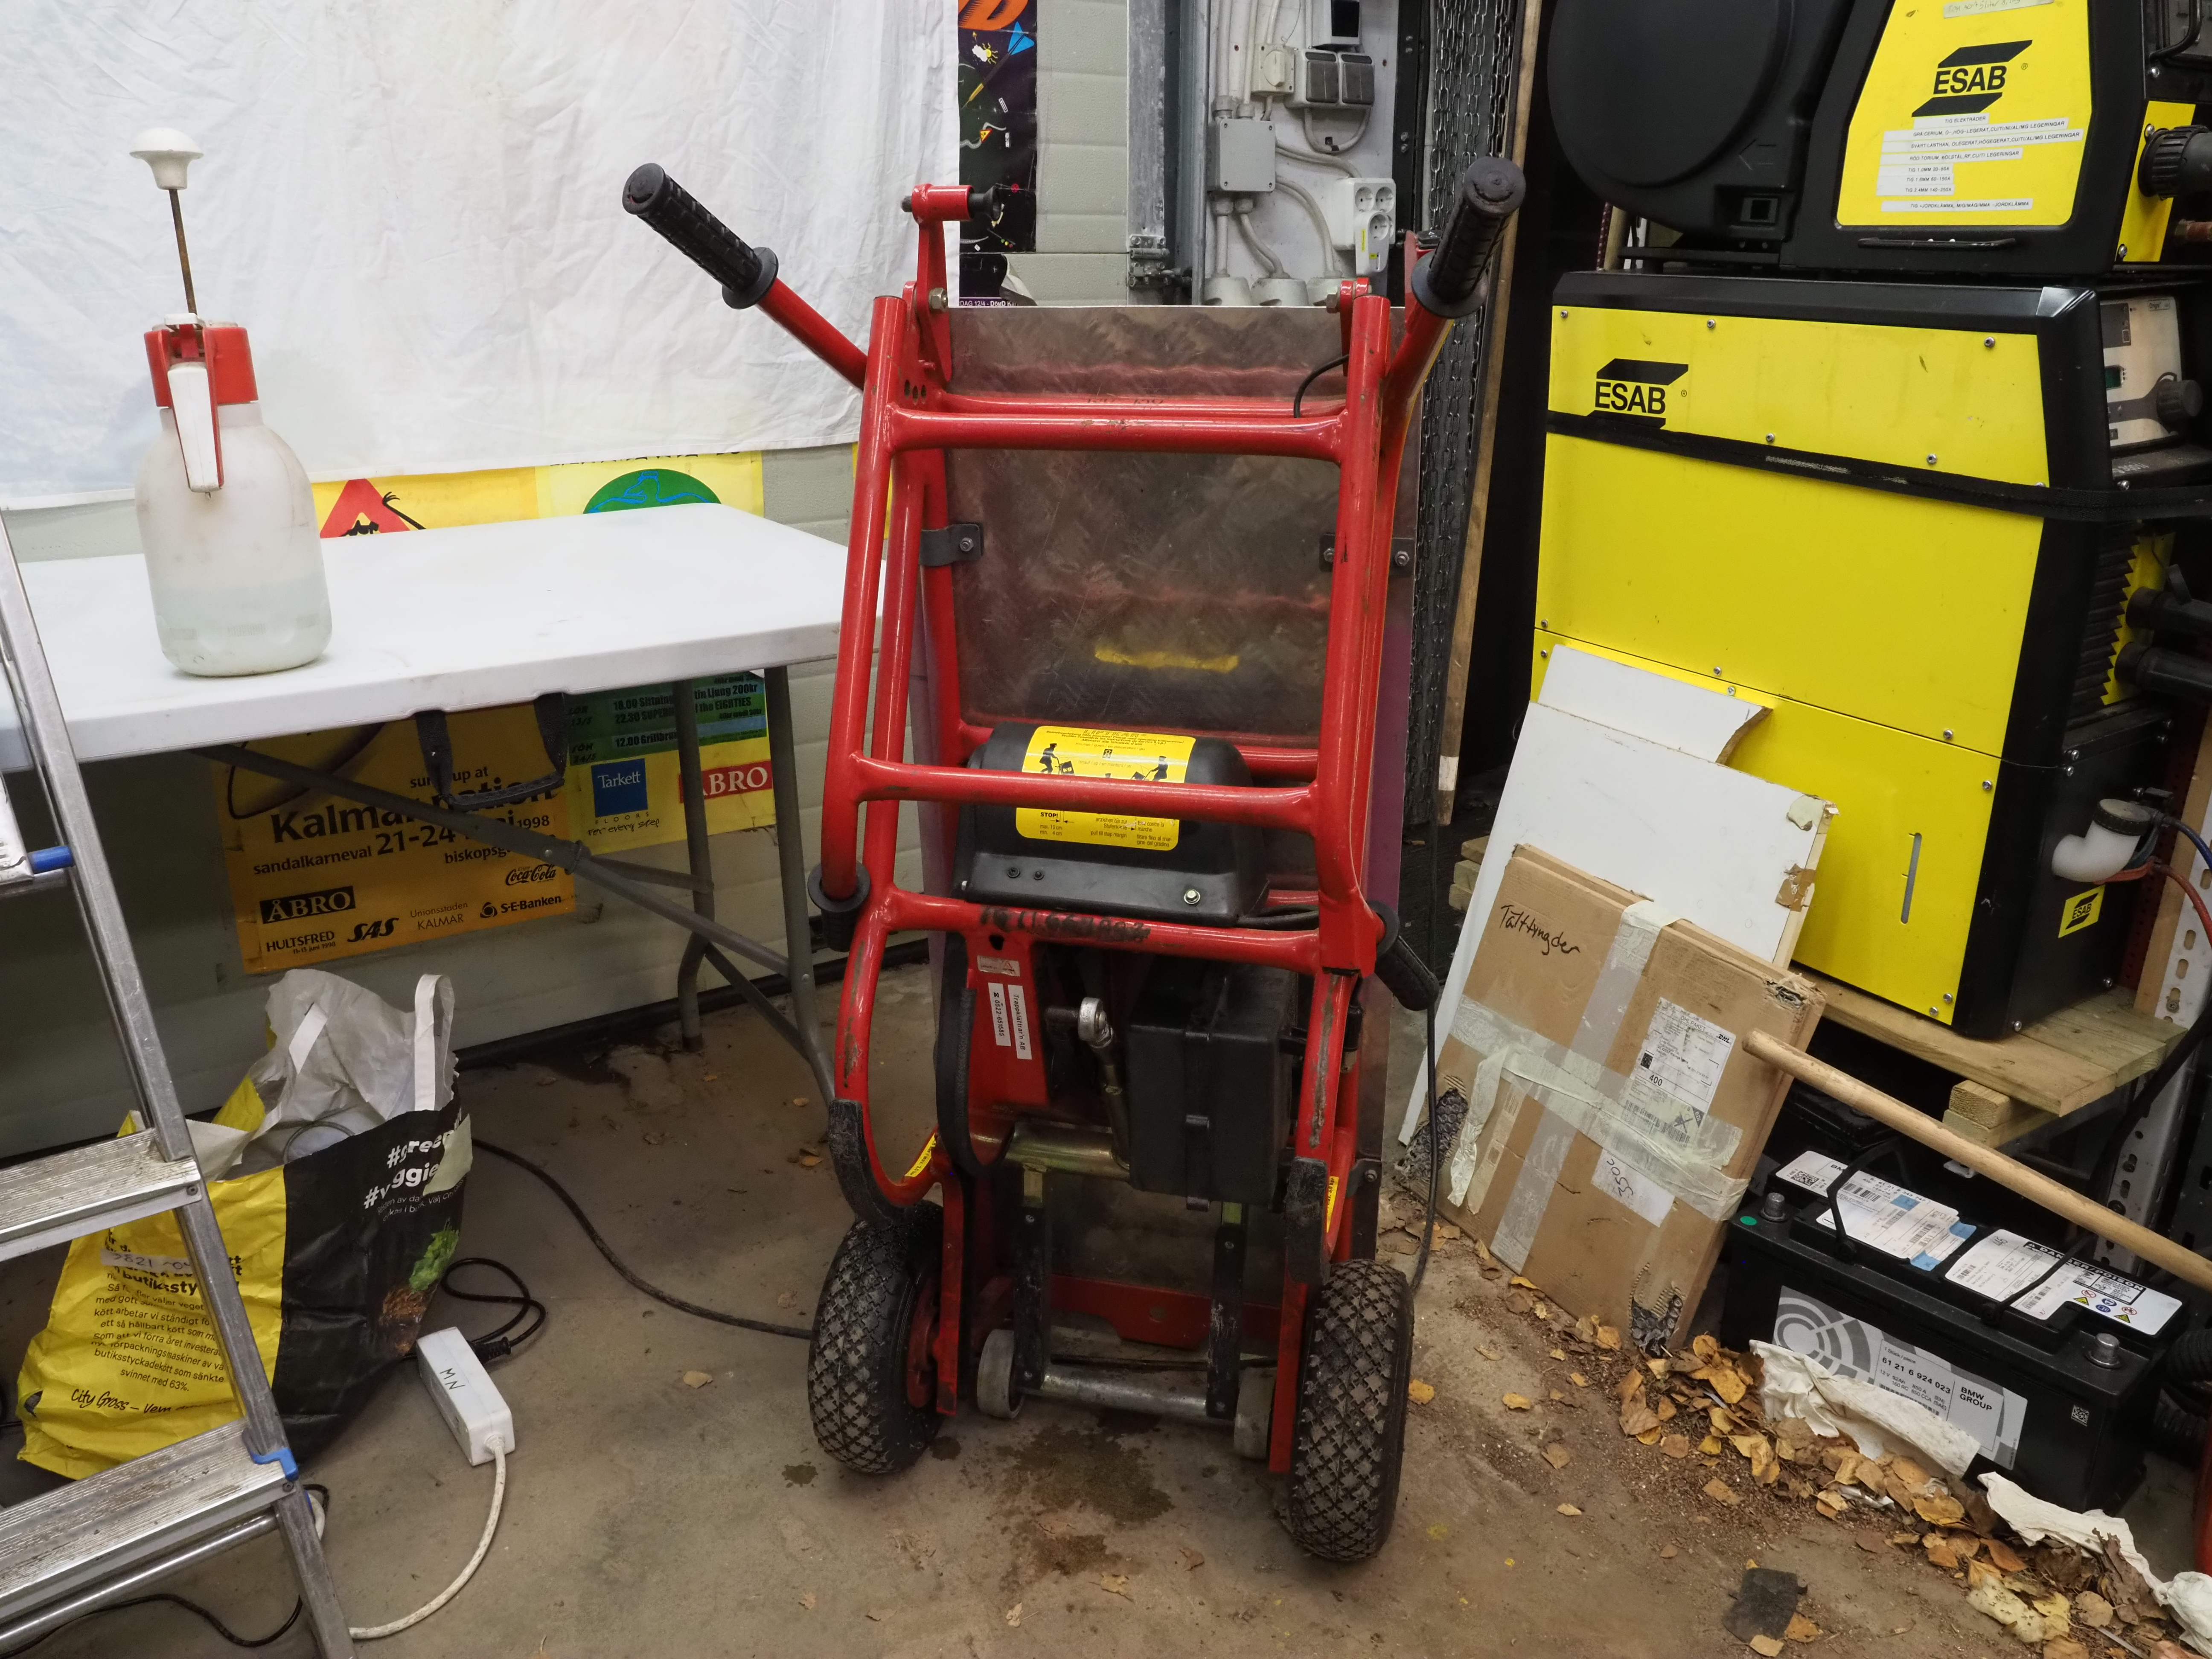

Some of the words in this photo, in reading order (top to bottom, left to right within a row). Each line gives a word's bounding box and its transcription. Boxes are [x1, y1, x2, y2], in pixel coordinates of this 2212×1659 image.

[1933, 65, 2007, 94] ESAB
[1595, 381, 1666, 414] ESAB
[715, 697, 752, 710] EIGHTIES
[453, 770, 471, 783] up
[475, 766, 489, 778] at
[598, 771, 641, 789] Tarkett
[703, 766, 768, 796] BRO
[608, 823, 635, 832] every
[638, 818, 660, 828] step
[253, 846, 373, 875] sandalkarneval
[375, 825, 456, 856] 21-24
[505, 864, 557, 886] Coca-Cola
[268, 891, 351, 923] ÅBRO
[410, 902, 469, 918] Unionsstaden
[2072, 903, 2092, 919] ESAB
[417, 914, 464, 930] KALMAR
[266, 931, 335, 952] HULTSFRED
[347, 917, 399, 943] SAS
[309, 944, 320, 953] juni
[1690, 1020, 1706, 1032] PAKET
[1019, 1041, 1026, 1050] AB
[1716, 1033, 1732, 1044] DHL
[1649, 1074, 1663, 1087] 400
[108, 1283, 120, 1292] Så
[96, 1295, 116, 1304] med
[118, 1295, 138, 1304] gott
[94, 1307, 114, 1316] kött
[116, 1307, 148, 1318] arbetar
[161, 1313, 199, 1326] ständigt
[101, 1319, 114, 1328] ett
[116, 1319, 125, 1328] så
[128, 1321, 165, 1330] hållbart
[167, 1324, 185, 1334] kött
[187, 1329, 204, 1338] som
[143, 1333, 164, 1343] förra
[166, 1336, 183, 1348] året
[94, 1348, 172, 1374] butiksstyckadekött
[174, 1368, 191, 1378] som
[193, 1372, 225, 1382] sänkte
[120, 1368, 151, 1382] svinnet
[151, 1376, 169, 1387] med
[169, 1380, 189, 1391] 63%.
[439, 1368, 466, 1390] MN
[1882, 1357, 1892, 1366] 61
[1895, 1363, 1904, 1372] 21
[1917, 1373, 1933, 1384] 924
[1935, 1381, 1950, 1394] 023
[71, 1388, 96, 1408] City
[96, 1391, 129, 1411] Gross
[1935, 1395, 1945, 1404] (EN)
[1961, 1386, 1985, 1400] BMW
[1921, 1394, 1932, 1402] CCA
[1933, 1400, 1947, 1411] (SAE)
[1959, 1394, 1993, 1411] GROUP
